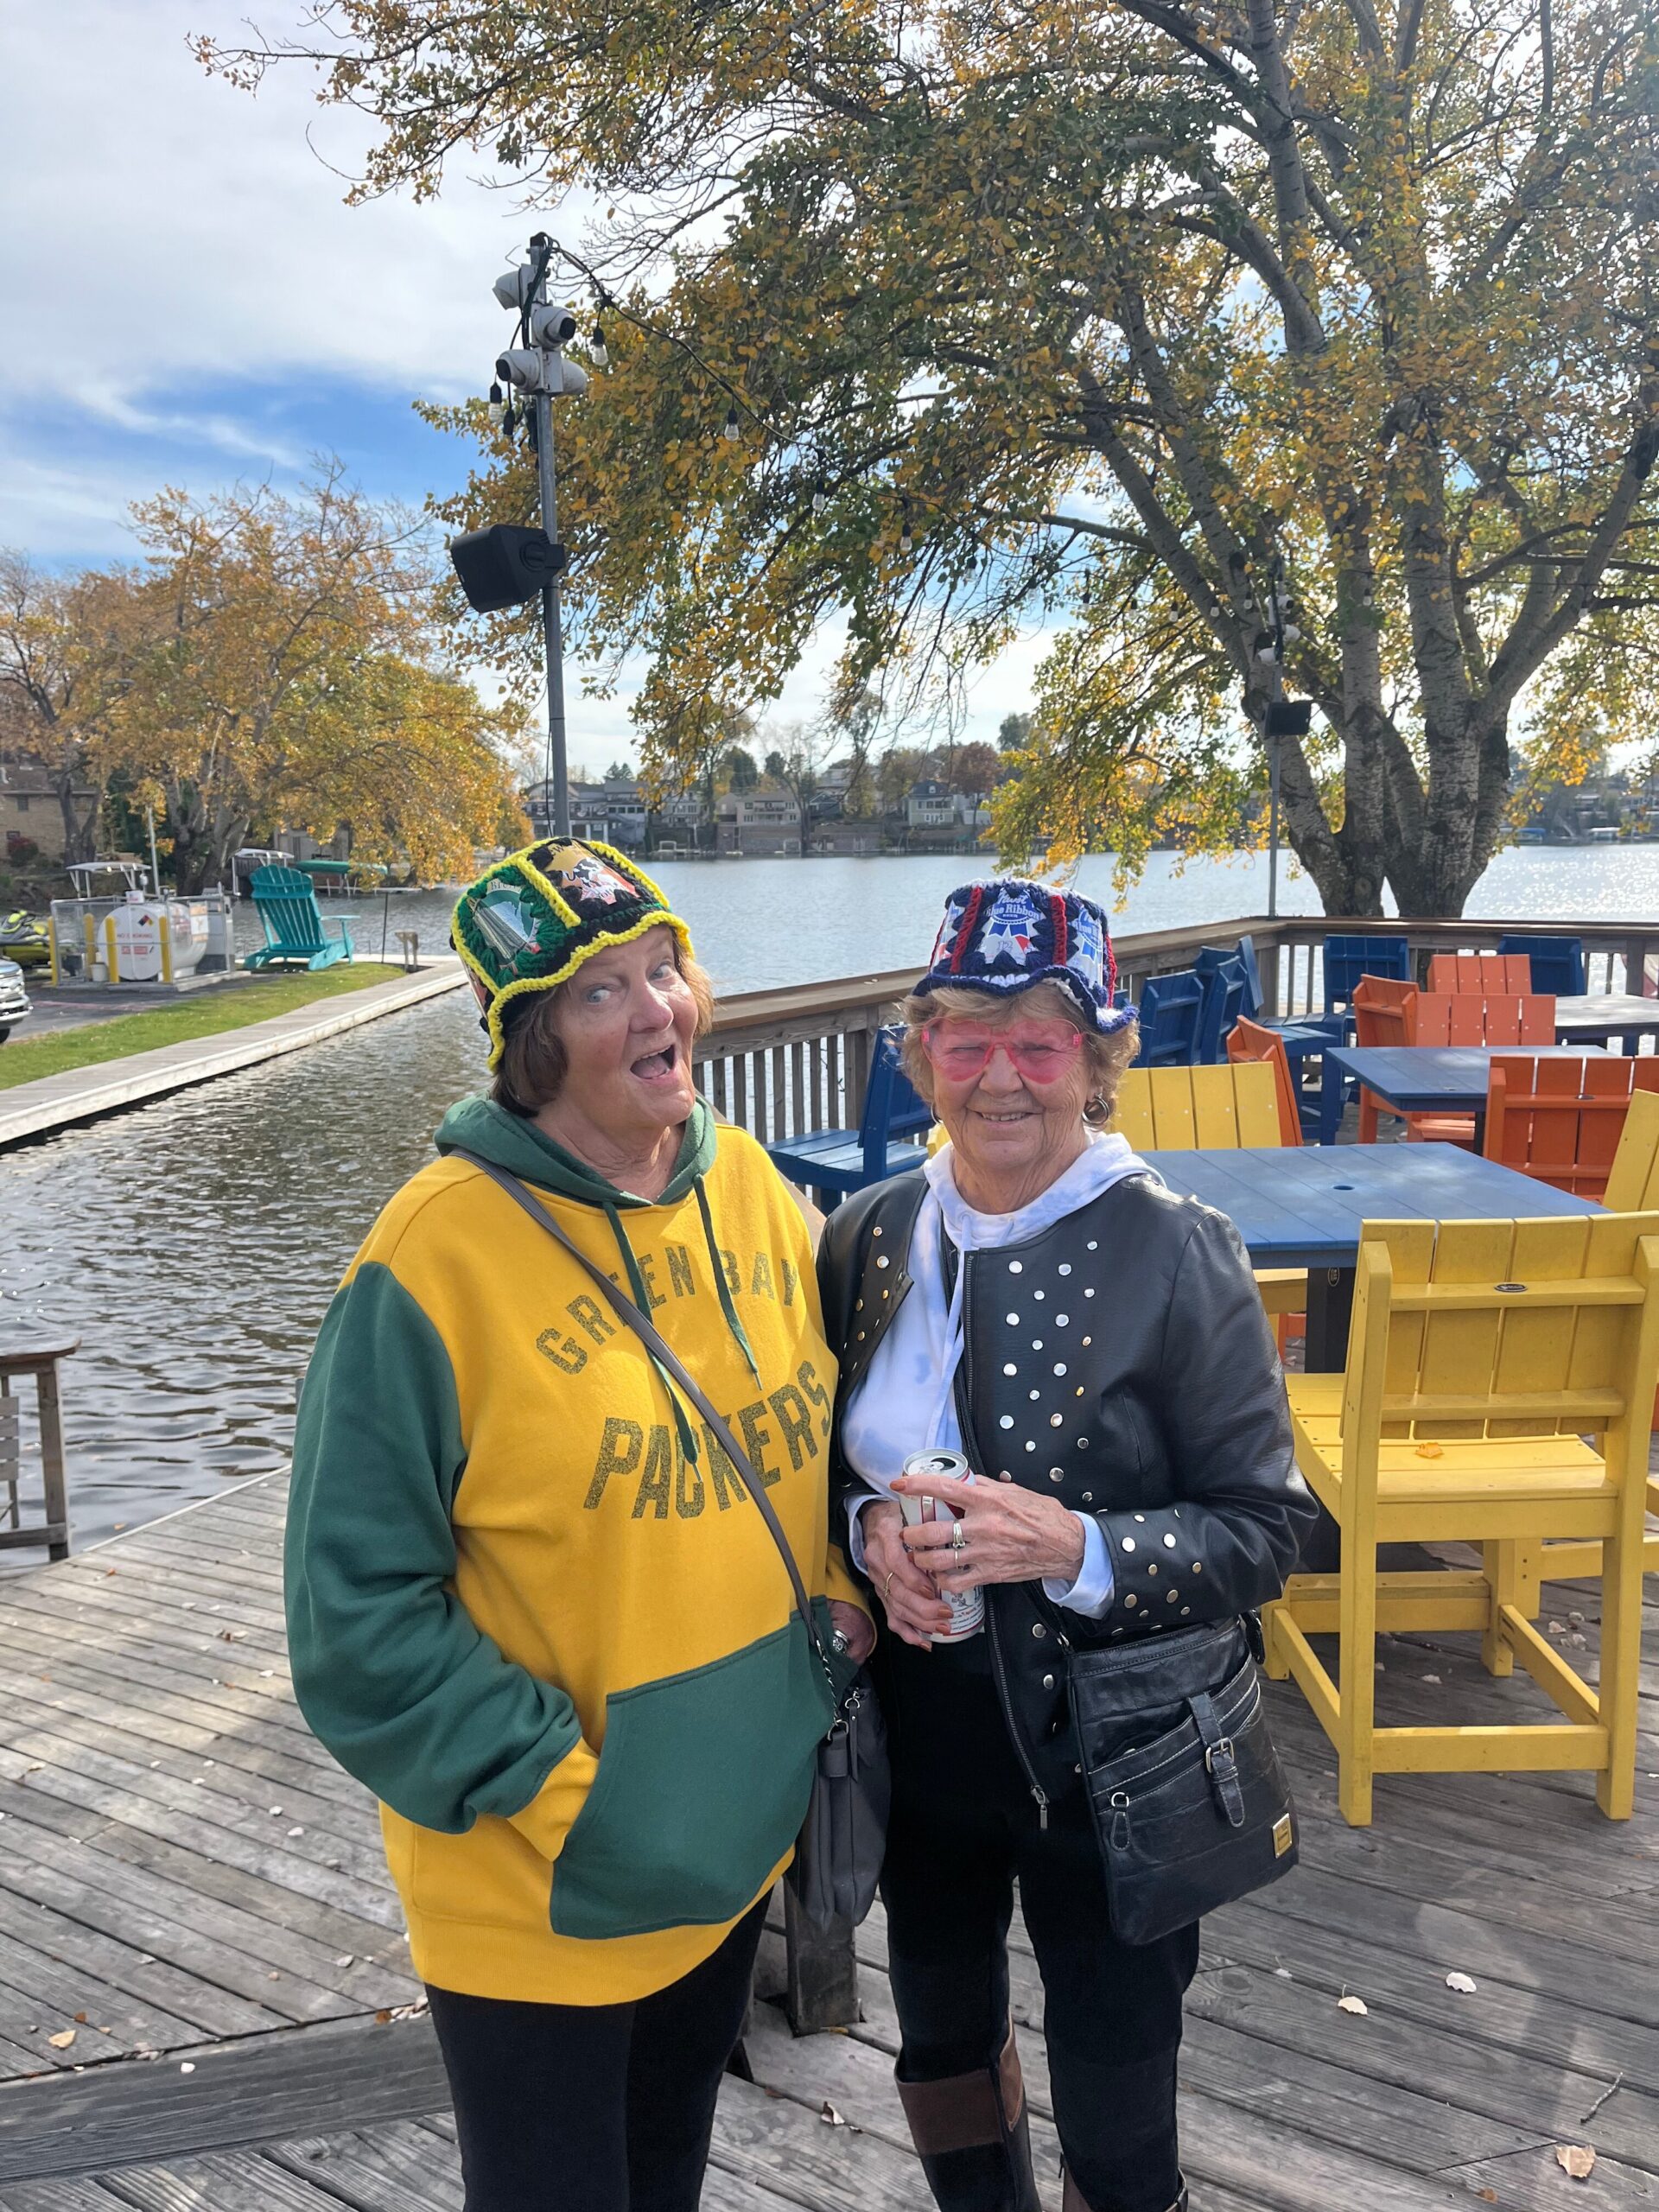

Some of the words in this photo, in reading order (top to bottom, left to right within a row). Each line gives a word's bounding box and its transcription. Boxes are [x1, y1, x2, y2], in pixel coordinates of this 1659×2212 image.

[1005, 903, 1039, 920] Ribbon
[719, 1249, 798, 1306] BAY
[582, 1359, 832, 1520] PACKERS
